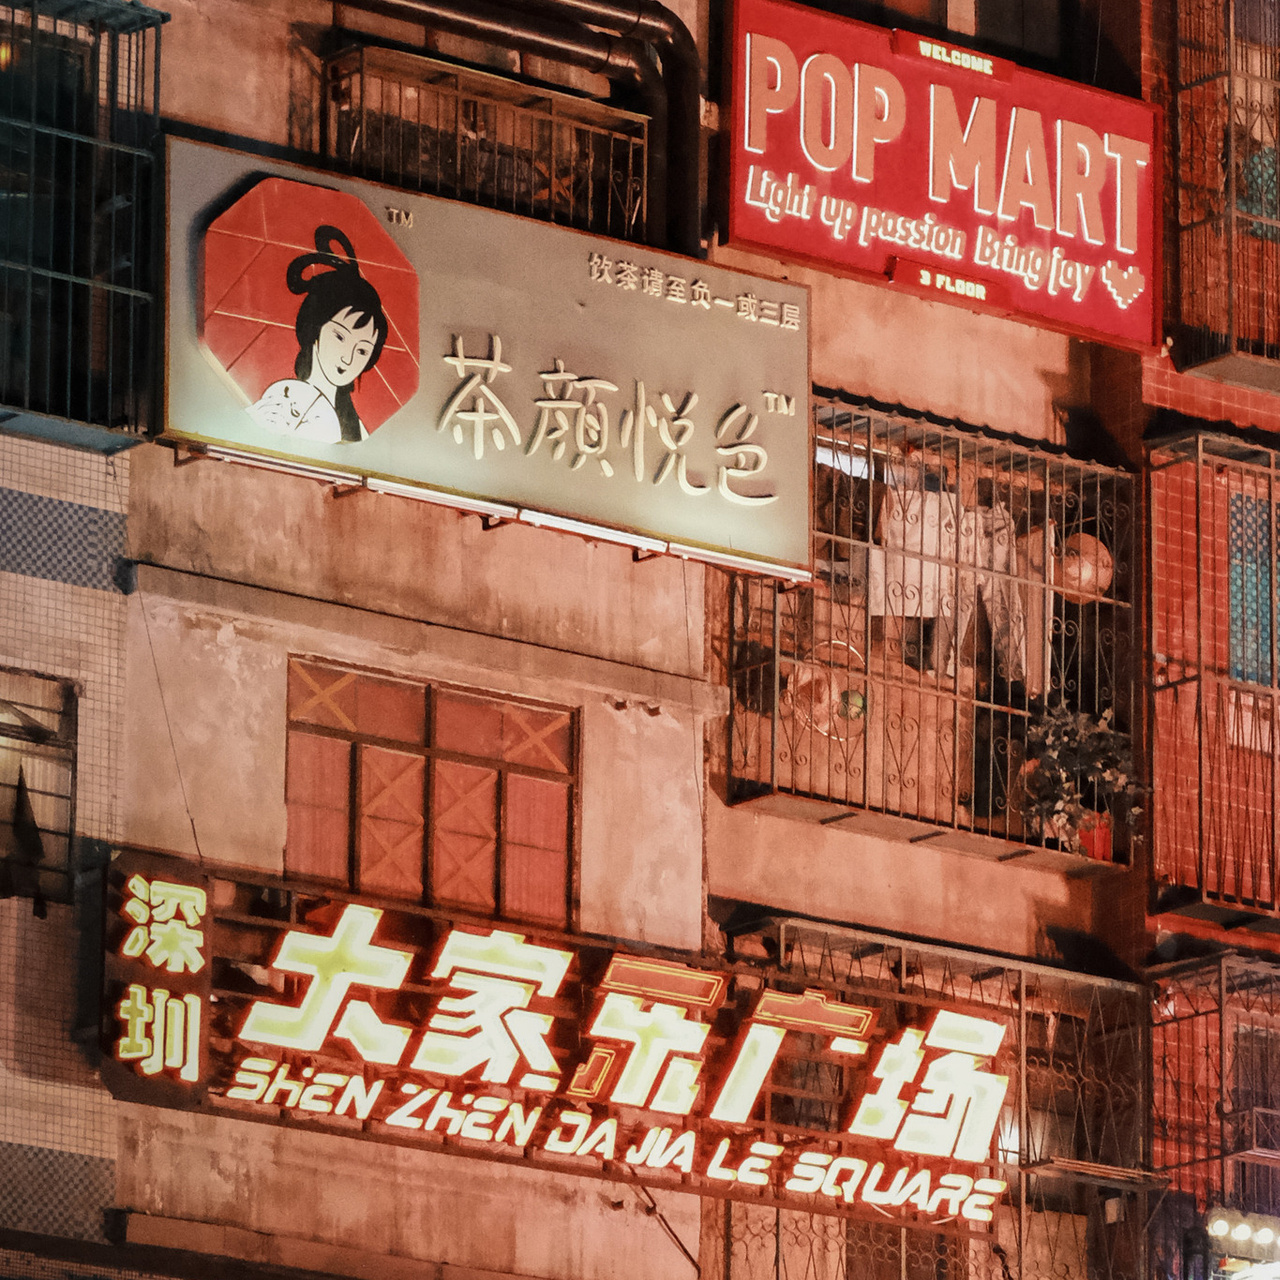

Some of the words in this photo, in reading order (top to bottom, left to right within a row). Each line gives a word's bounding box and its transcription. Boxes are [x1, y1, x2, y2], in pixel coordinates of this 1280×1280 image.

[919, 39, 994, 76] WELCOME
[744, 32, 907, 184] POP
[929, 83, 1151, 255] MART
[745, 163, 818, 222] Light
[820, 193, 858, 240] up
[859, 206, 967, 261] passion
[589, 252, 801, 332] 饮茶请至负一或三层
[935, 272, 987, 301] FLOOR
[117, 872, 209, 1083] 深圳
[227, 1056, 386, 1121] SHEN
[395, 1081, 541, 1149] ZHEN
[543, 1110, 616, 1160] DA
[624, 1125, 696, 1175] JIA
[706, 1138, 785, 1185] LE
[785, 1151, 1008, 1224] SQUARE
